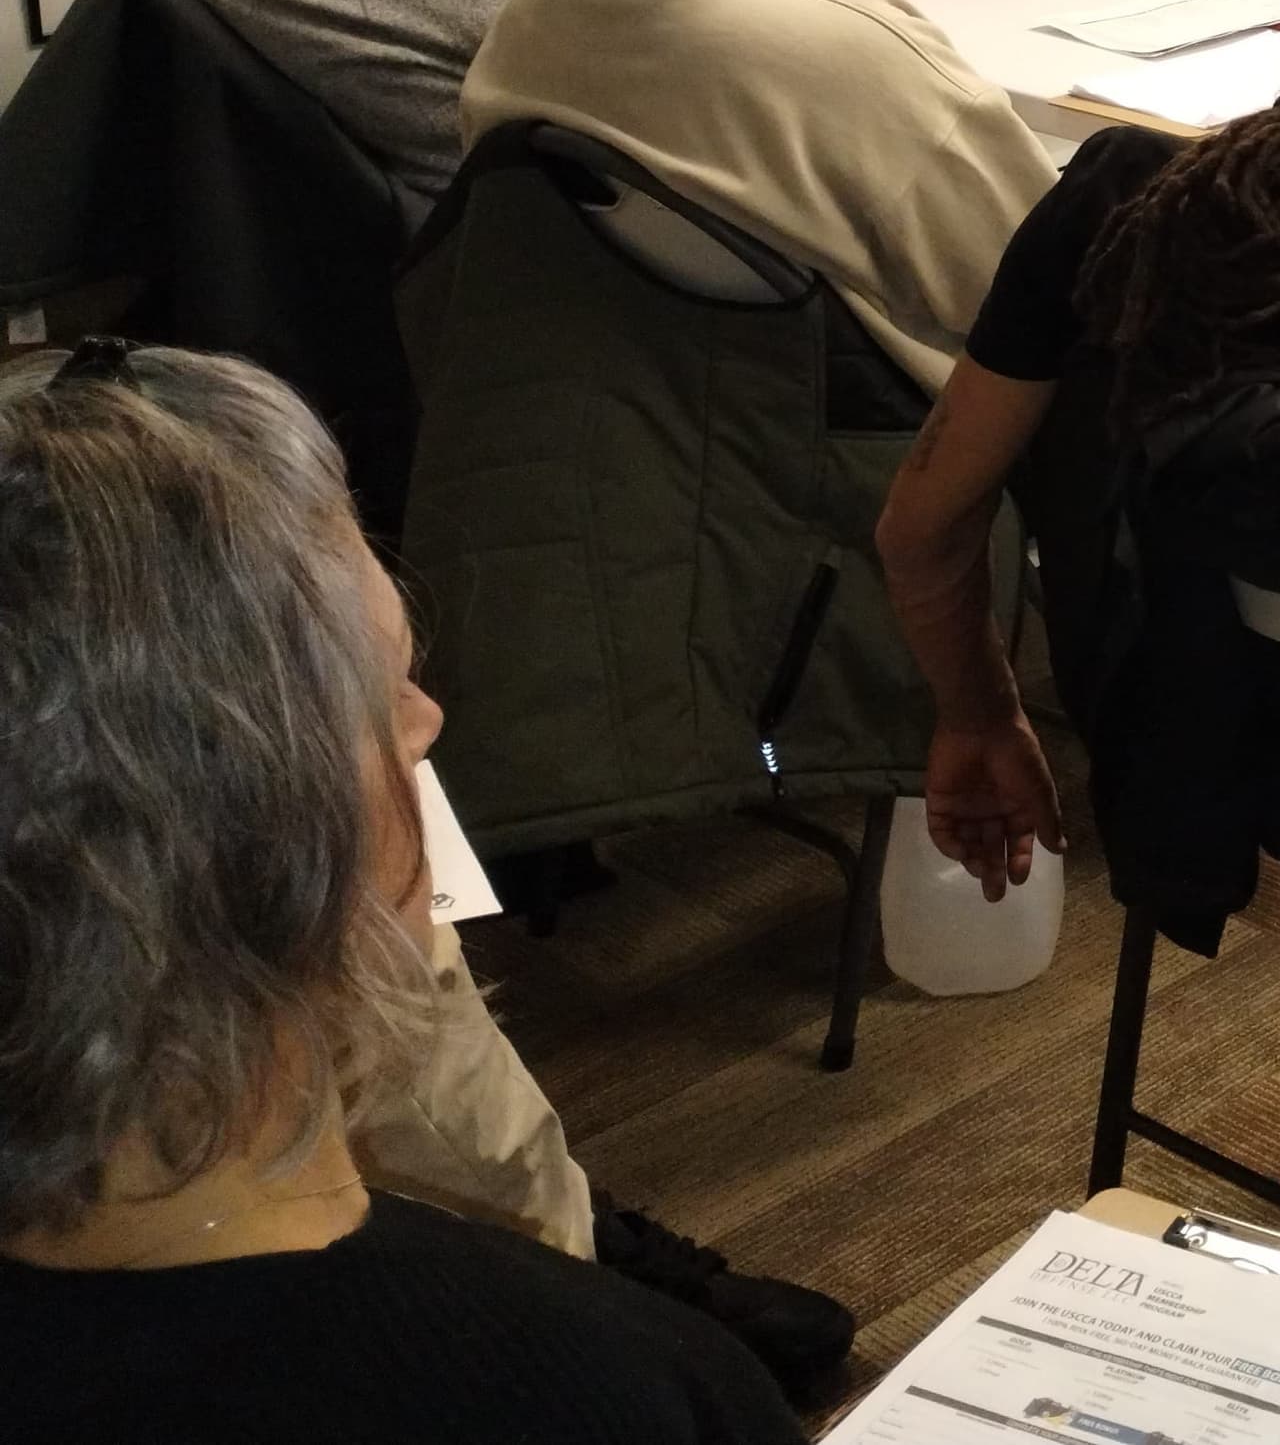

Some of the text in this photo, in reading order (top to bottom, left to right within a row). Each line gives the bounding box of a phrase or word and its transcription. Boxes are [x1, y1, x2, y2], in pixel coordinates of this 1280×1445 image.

[1040, 1250, 1146, 1298] DELTA
[1153, 1286, 1183, 1301] USCCA
[1140, 1302, 1185, 1319] PROGRAM
[1012, 1295, 1037, 1310] JOIN
[1038, 1302, 1058, 1316] THE
[1060, 1308, 1096, 1326] USCCA
[1098, 1318, 1135, 1338] TODAY
[1136, 1329, 1162, 1344] AND
[1162, 1337, 1199, 1356] CLAIM
[1200, 1348, 1233, 1367] YOUR
[1232, 1358, 1263, 1377] FREE
